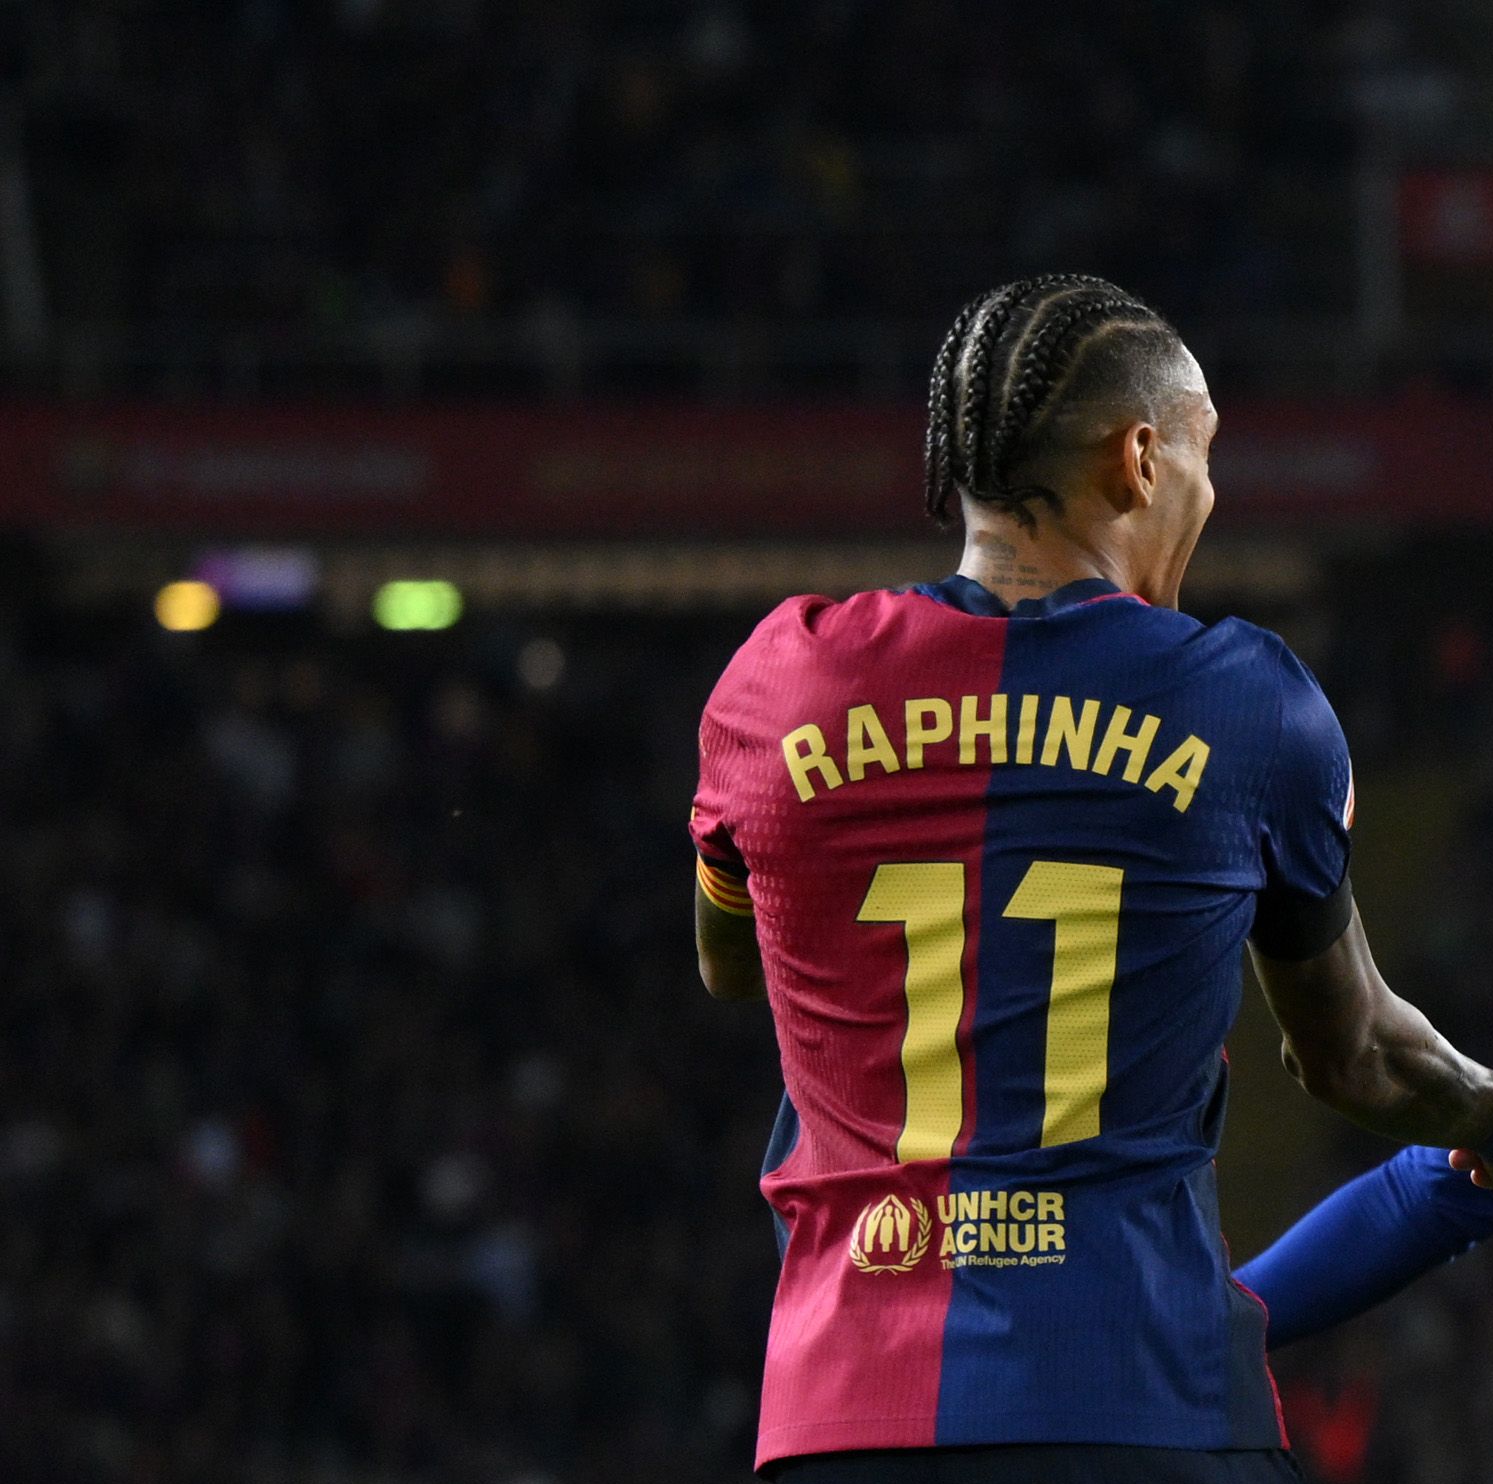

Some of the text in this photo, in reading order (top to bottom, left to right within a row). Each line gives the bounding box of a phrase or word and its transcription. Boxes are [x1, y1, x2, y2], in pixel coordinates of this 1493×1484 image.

[781, 694, 1211, 813] RAPHINHA
[856, 861, 1125, 1164] 11
[937, 1190, 1065, 1224] UNHCR
[940, 1223, 1066, 1256] ACNUR
[968, 1255, 1018, 1268] Refugee
[1020, 1254, 1066, 1267] Agency
